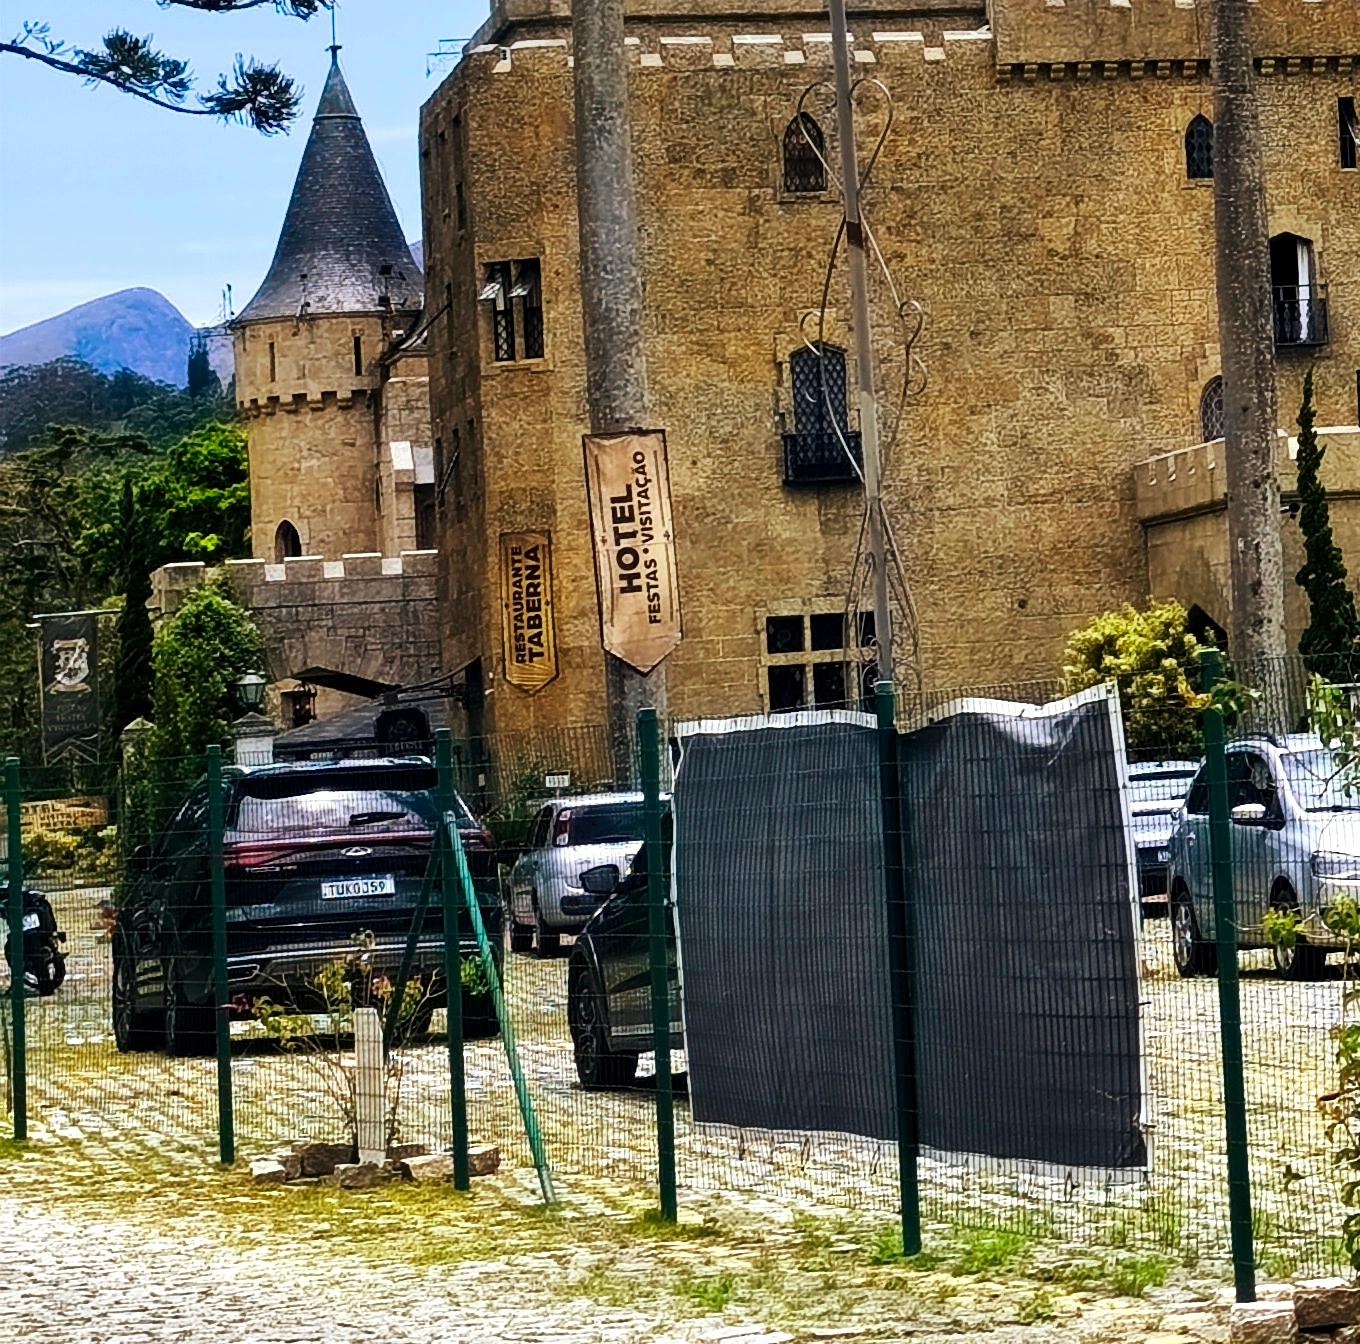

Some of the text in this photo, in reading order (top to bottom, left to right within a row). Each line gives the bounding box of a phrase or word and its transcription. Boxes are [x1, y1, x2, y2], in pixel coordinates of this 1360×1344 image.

[610, 483, 643, 594] HOTEL
[632, 451, 662, 624] FESTAS VISITAÇÃO
[511, 545, 527, 665] RESTAURANTE
[525, 545, 545, 664] TABERNA
